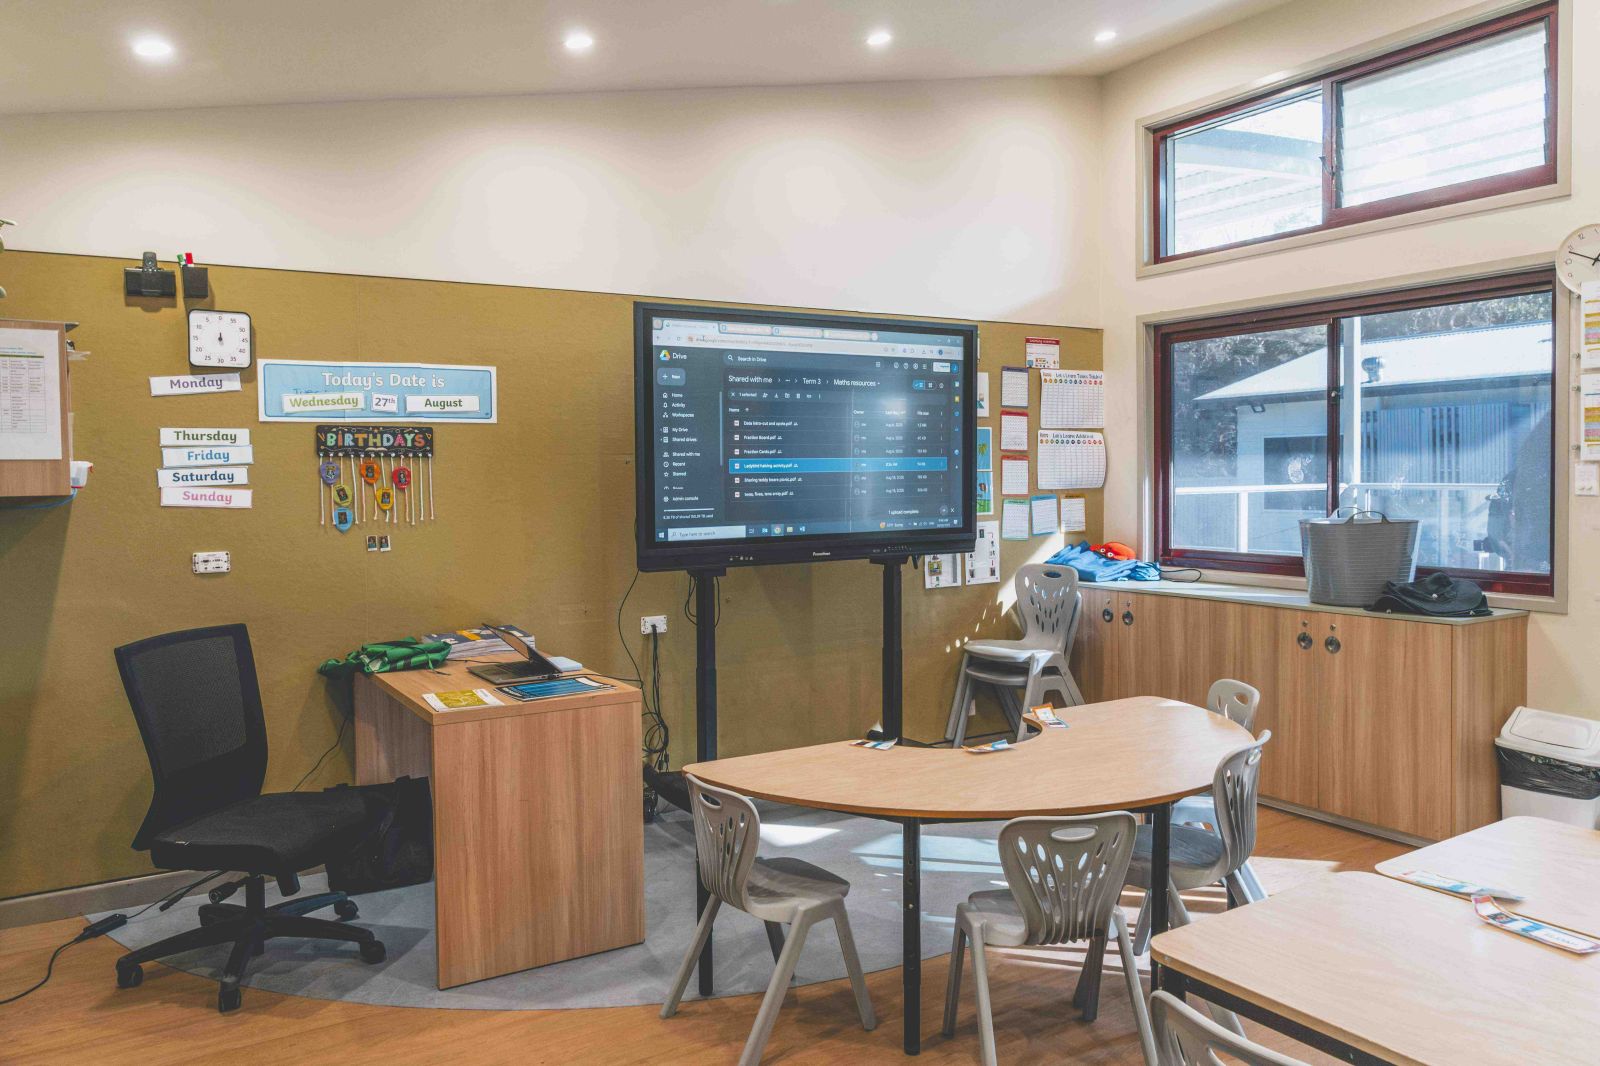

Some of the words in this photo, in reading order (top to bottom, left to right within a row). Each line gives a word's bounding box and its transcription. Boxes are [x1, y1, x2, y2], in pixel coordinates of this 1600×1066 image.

[170, 377, 223, 389] Monday
[322, 372, 384, 390] Today's
[390, 372, 426, 388] Date
[431, 374, 445, 388] is
[289, 396, 358, 408] Wednesday
[374, 397, 395, 407] 27th
[424, 398, 462, 410] August
[173, 430, 237, 444] Thursday
[326, 431, 425, 448] BIRTHDAYS
[187, 450, 230, 462] Friday
[172, 470, 234, 483] Saturday
[182, 490, 232, 505] Sunday
